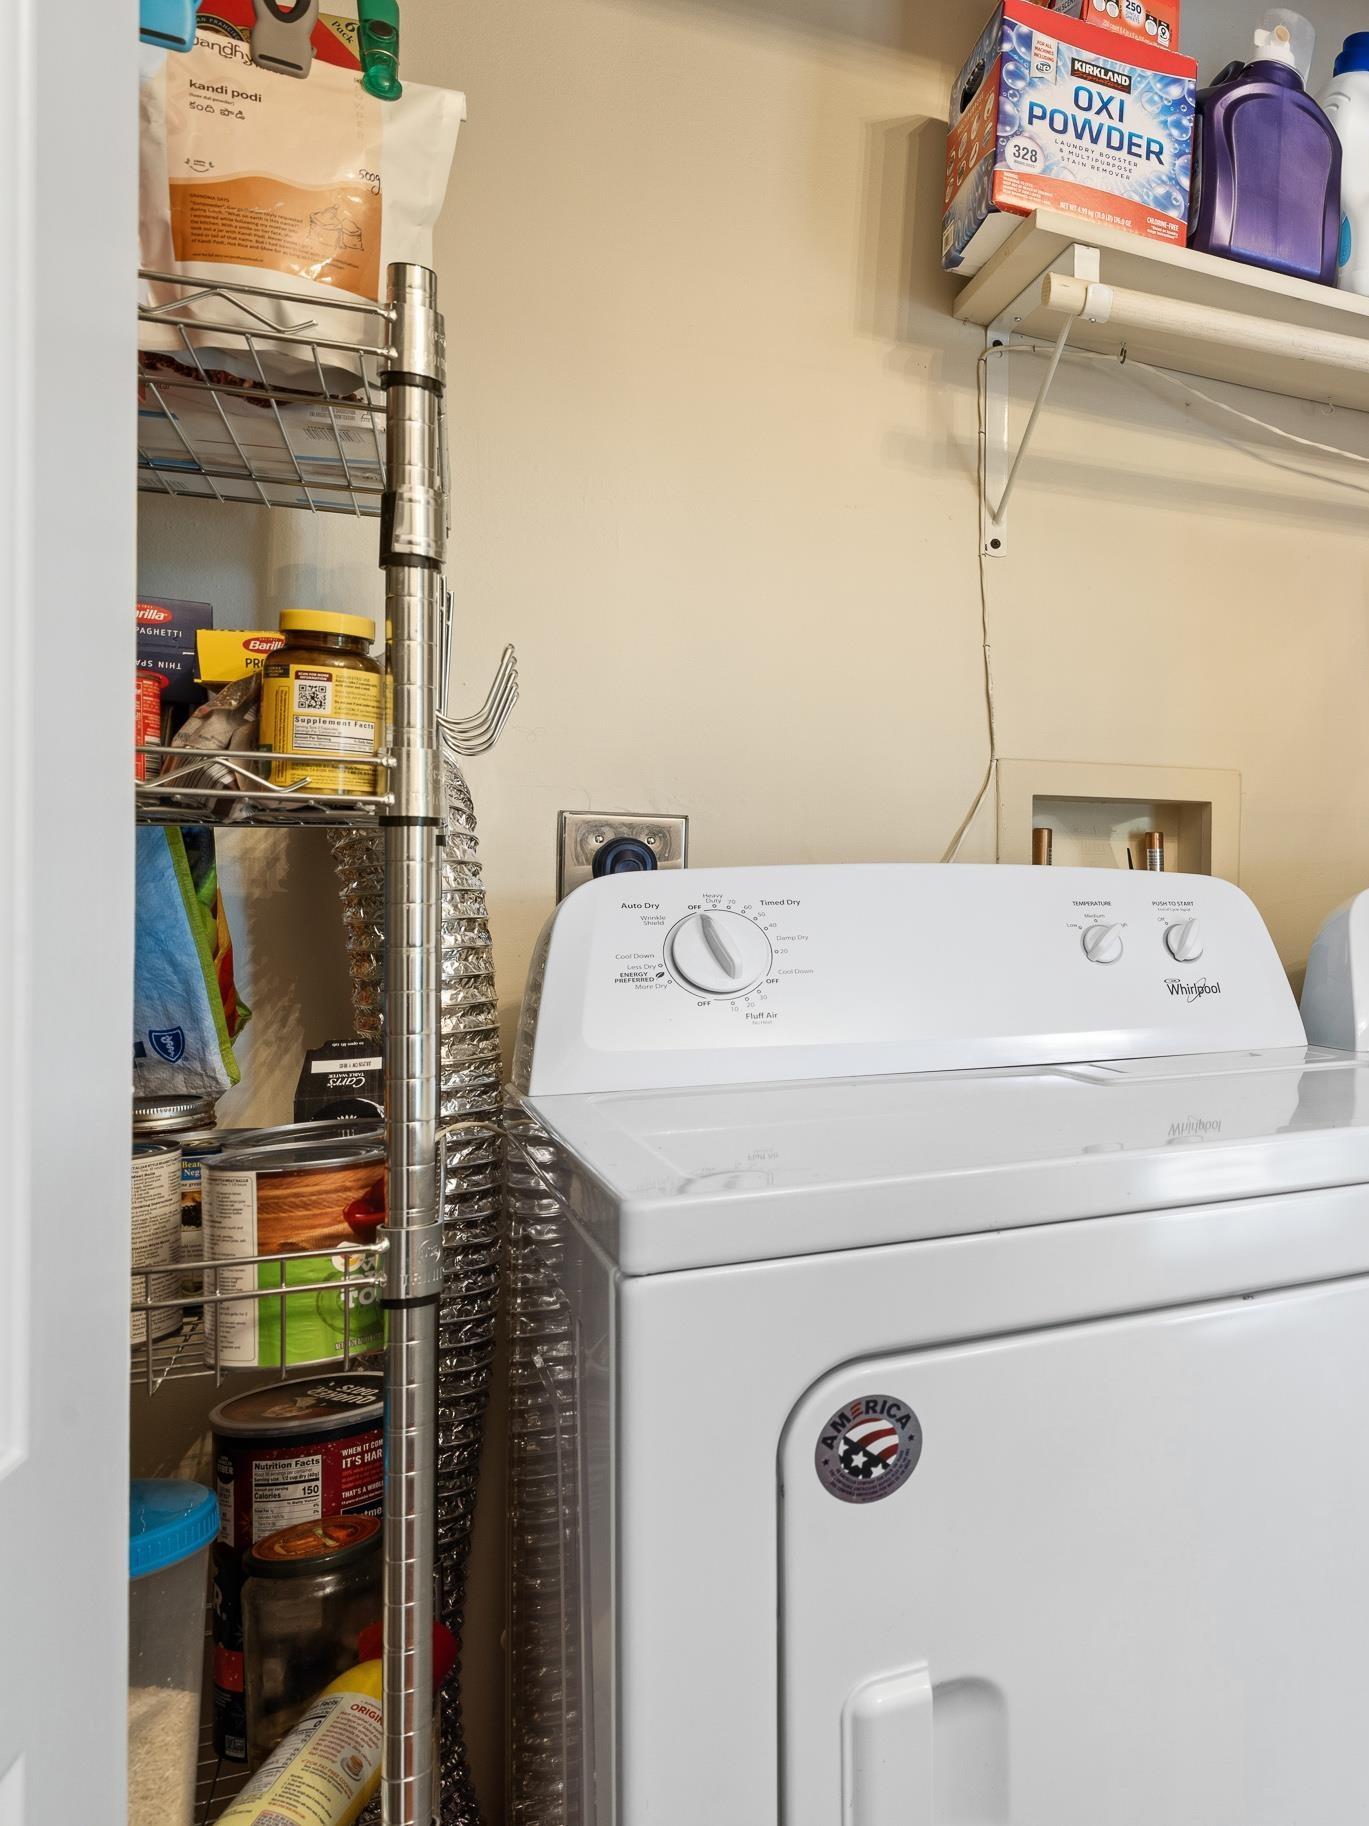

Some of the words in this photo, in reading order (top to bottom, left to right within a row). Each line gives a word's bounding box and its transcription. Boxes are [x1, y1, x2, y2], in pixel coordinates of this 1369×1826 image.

[1125, 2, 1142, 14] 250
[331, 20, 354, 44] Pack
[345, 22, 358, 32] 6
[1074, 60, 1130, 85] KIRKLAND
[189, 79, 228, 95] kandi
[231, 90, 262, 102] podi
[1073, 85, 1125, 123] OXI
[1027, 100, 1165, 166] POWDER
[1013, 145, 1038, 163] 328
[1055, 139, 1095, 154] LAUNDRY
[1099, 152, 1138, 168] BOOSTER
[1061, 156, 1086, 167] STAIN
[1091, 165, 1131, 180] REMOVER
[1068, 150, 1133, 174] MULTIPURPOSE
[158, 661, 182, 670] THIN
[295, 716, 351, 727] Supplement
[354, 721, 374, 729] Facts
[644, 902, 660, 910] Dry
[1166, 980, 1221, 999] Whirlpool
[745, 1012, 764, 1020] Fluff
[821, 1399, 912, 1450] AMERICA
[341, 1445, 362, 1457] WHEN
[362, 1443, 370, 1451] IT
[254, 1461, 292, 1470] Nutrition
[294, 1458, 320, 1467] Facts
[342, 1455, 362, 1469] IT'S
[254, 1491, 281, 1500] Calories
[302, 1484, 319, 1495] 150
[342, 1487, 362, 1498] THAT'S
